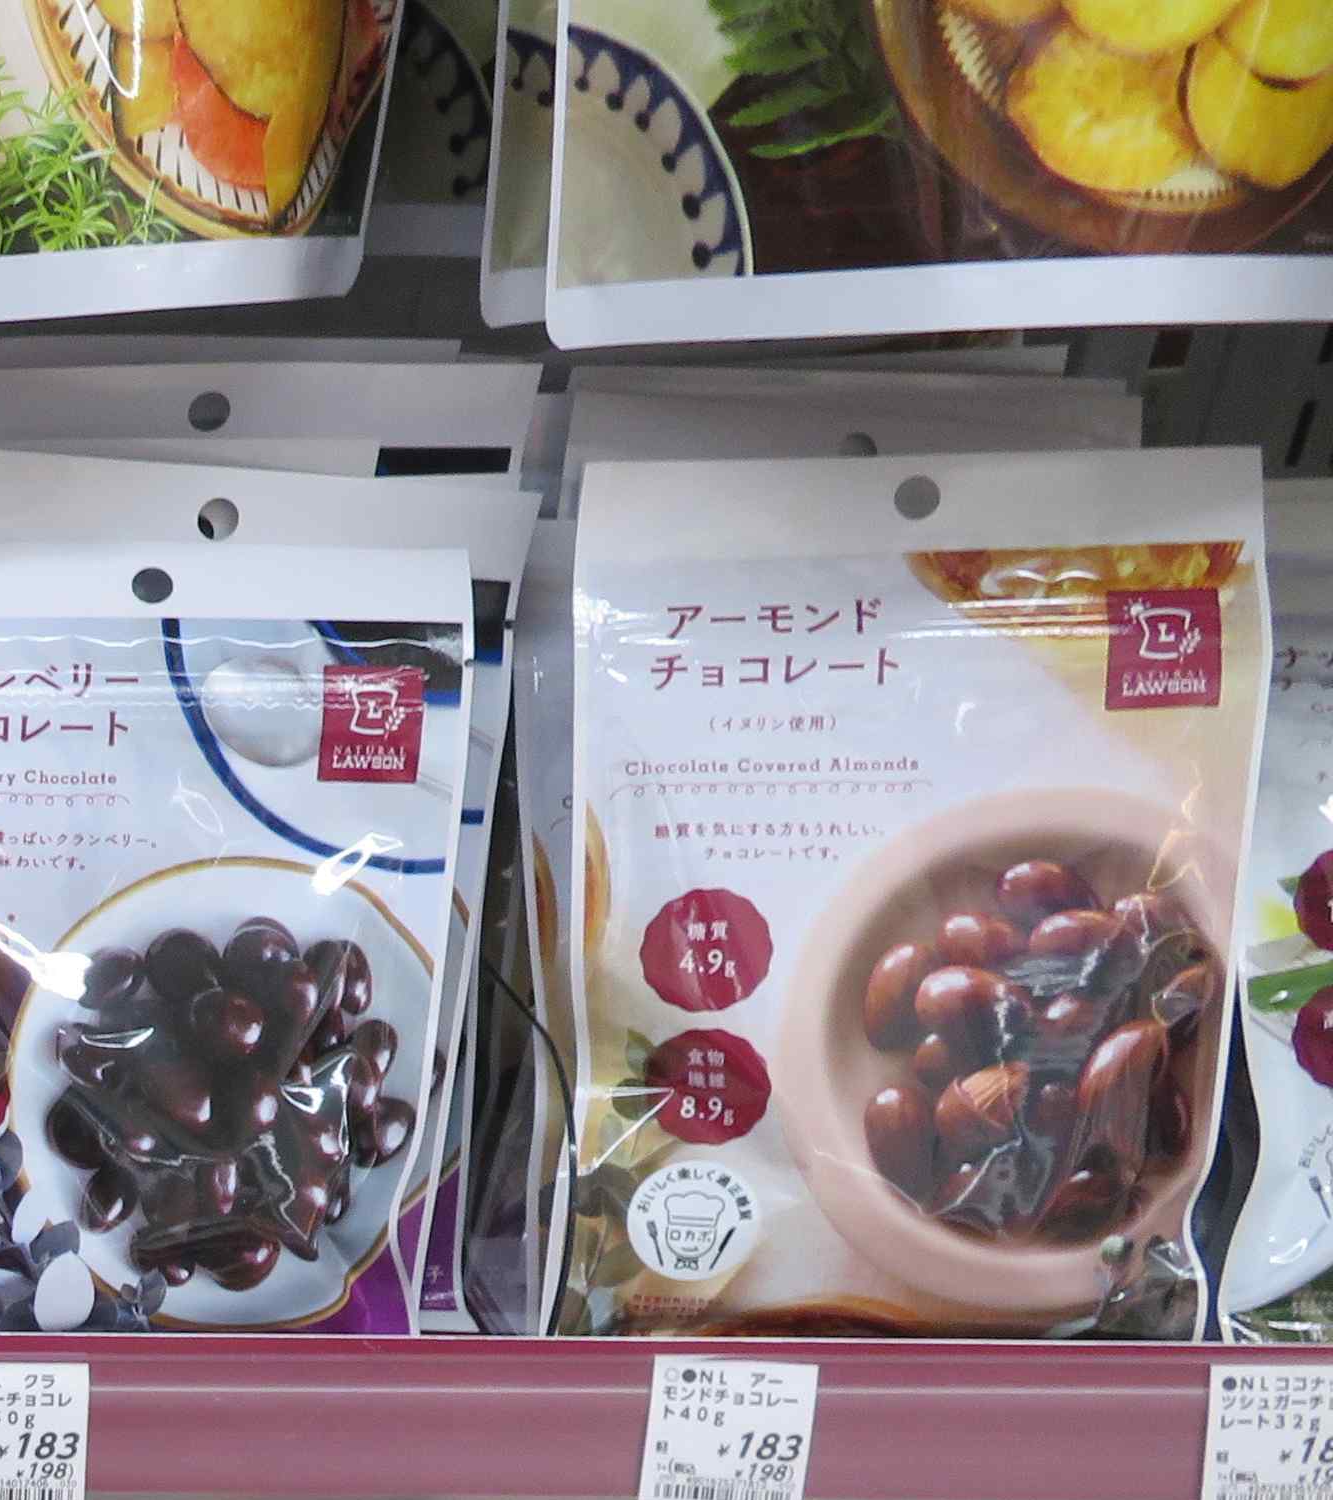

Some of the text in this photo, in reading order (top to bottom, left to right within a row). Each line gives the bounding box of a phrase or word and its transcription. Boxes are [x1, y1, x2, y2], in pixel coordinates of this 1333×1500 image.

[666, 596, 883, 639] アーモンド
[651, 646, 901, 691] チョコレート
[624, 756, 920, 776] Chocolate Covered Almonds
[23, 768, 118, 786] Chocolate
[687, 920, 729, 941] 糖質
[679, 949, 737, 978] 4.9g
[687, 1047, 725, 1068] 食物
[679, 1094, 735, 1126] 8.9g
[24, 1374, 55, 1389] クラ
[663, 1385, 798, 1407] モンドチョコレー
